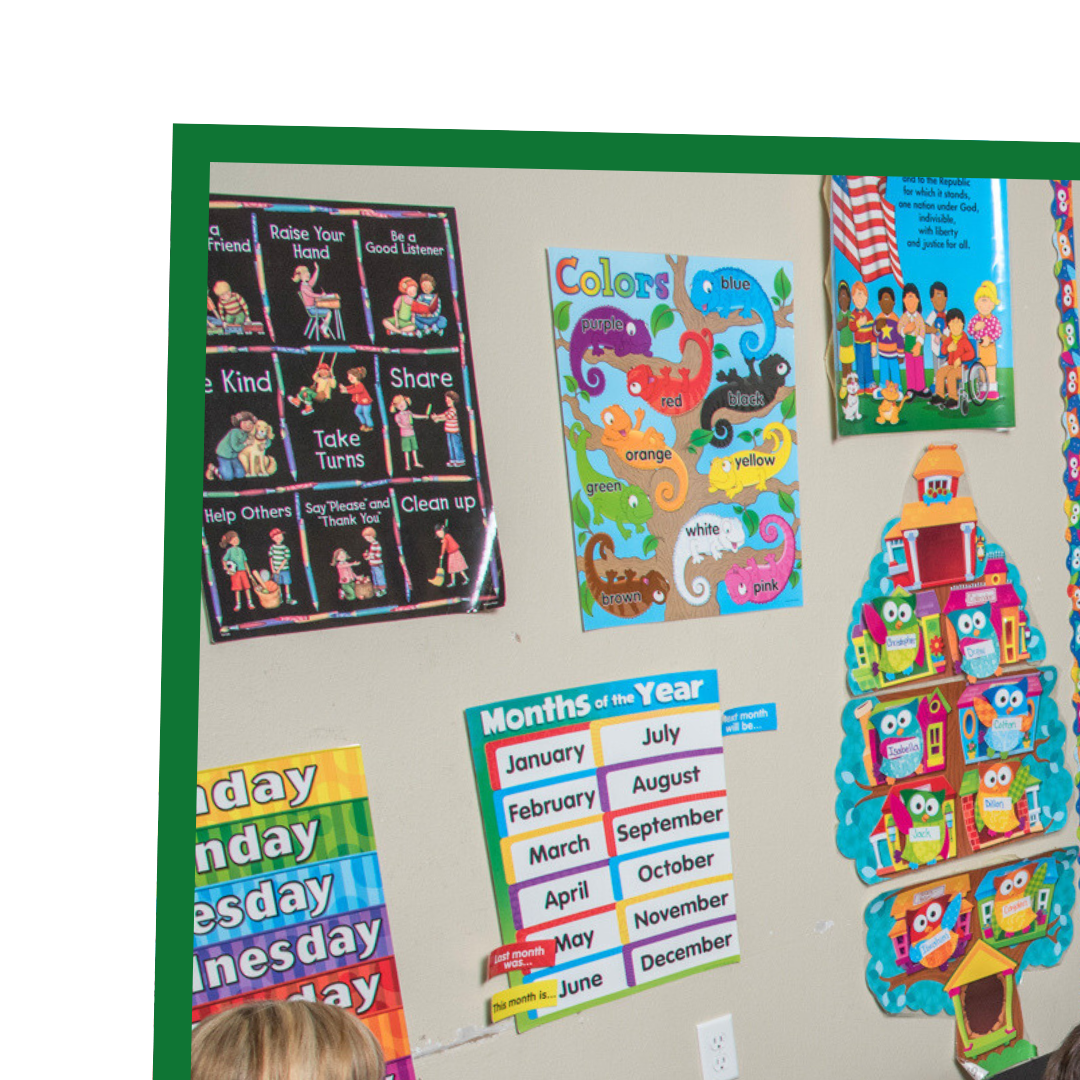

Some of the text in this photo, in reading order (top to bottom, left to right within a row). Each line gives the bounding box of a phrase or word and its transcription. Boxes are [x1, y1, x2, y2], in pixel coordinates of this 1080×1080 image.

[903, 185, 913, 196] for
[915, 187, 935, 198] which
[938, 188, 944, 198] it
[939, 177, 970, 188] Republic
[898, 201, 979, 213] one nation under God,
[270, 223, 346, 244] Raise Your
[390, 229, 417, 243] Be a
[918, 226, 958, 239] with liberty
[293, 243, 330, 260] Hand
[365, 241, 445, 257] Good Listener
[907, 238, 920, 248] and
[922, 239, 944, 250] justice
[946, 239, 956, 249] for
[555, 255, 670, 301] Colors
[721, 275, 751, 292] blue
[581, 316, 624, 334] purple
[220, 368, 273, 394] Kind
[390, 366, 454, 389] Share
[660, 393, 683, 408] red
[728, 390, 765, 407] black
[313, 429, 361, 449] Take
[314, 450, 366, 470] Turns
[625, 448, 672, 464] orange
[734, 453, 776, 470] yellow
[586, 480, 622, 497] green
[304, 501, 327, 516] Say
[368, 496, 392, 510] and
[401, 495, 477, 513] Clean up
[203, 504, 293, 526] Help Others
[685, 522, 720, 538] white
[752, 578, 779, 597] pink
[600, 591, 642, 606] brown
[480, 678, 705, 737] Months of the Year
[740, 708, 769, 721] month
[642, 724, 681, 746] July
[726, 722, 740, 732] will
[888, 741, 920, 757] Isabella
[505, 743, 586, 775] January
[632, 765, 702, 794] August
[508, 790, 596, 824] February
[984, 798, 1004, 809] Dillon
[616, 806, 724, 842] September
[528, 834, 590, 866] March
[638, 851, 715, 883] October
[544, 880, 590, 911] April
[634, 892, 730, 930] November
[554, 930, 594, 954] May
[494, 946, 546, 964] Last month
[640, 932, 733, 973] December
[559, 972, 604, 999] June
[492, 1000, 507, 1014] This
[508, 992, 536, 1008] month
